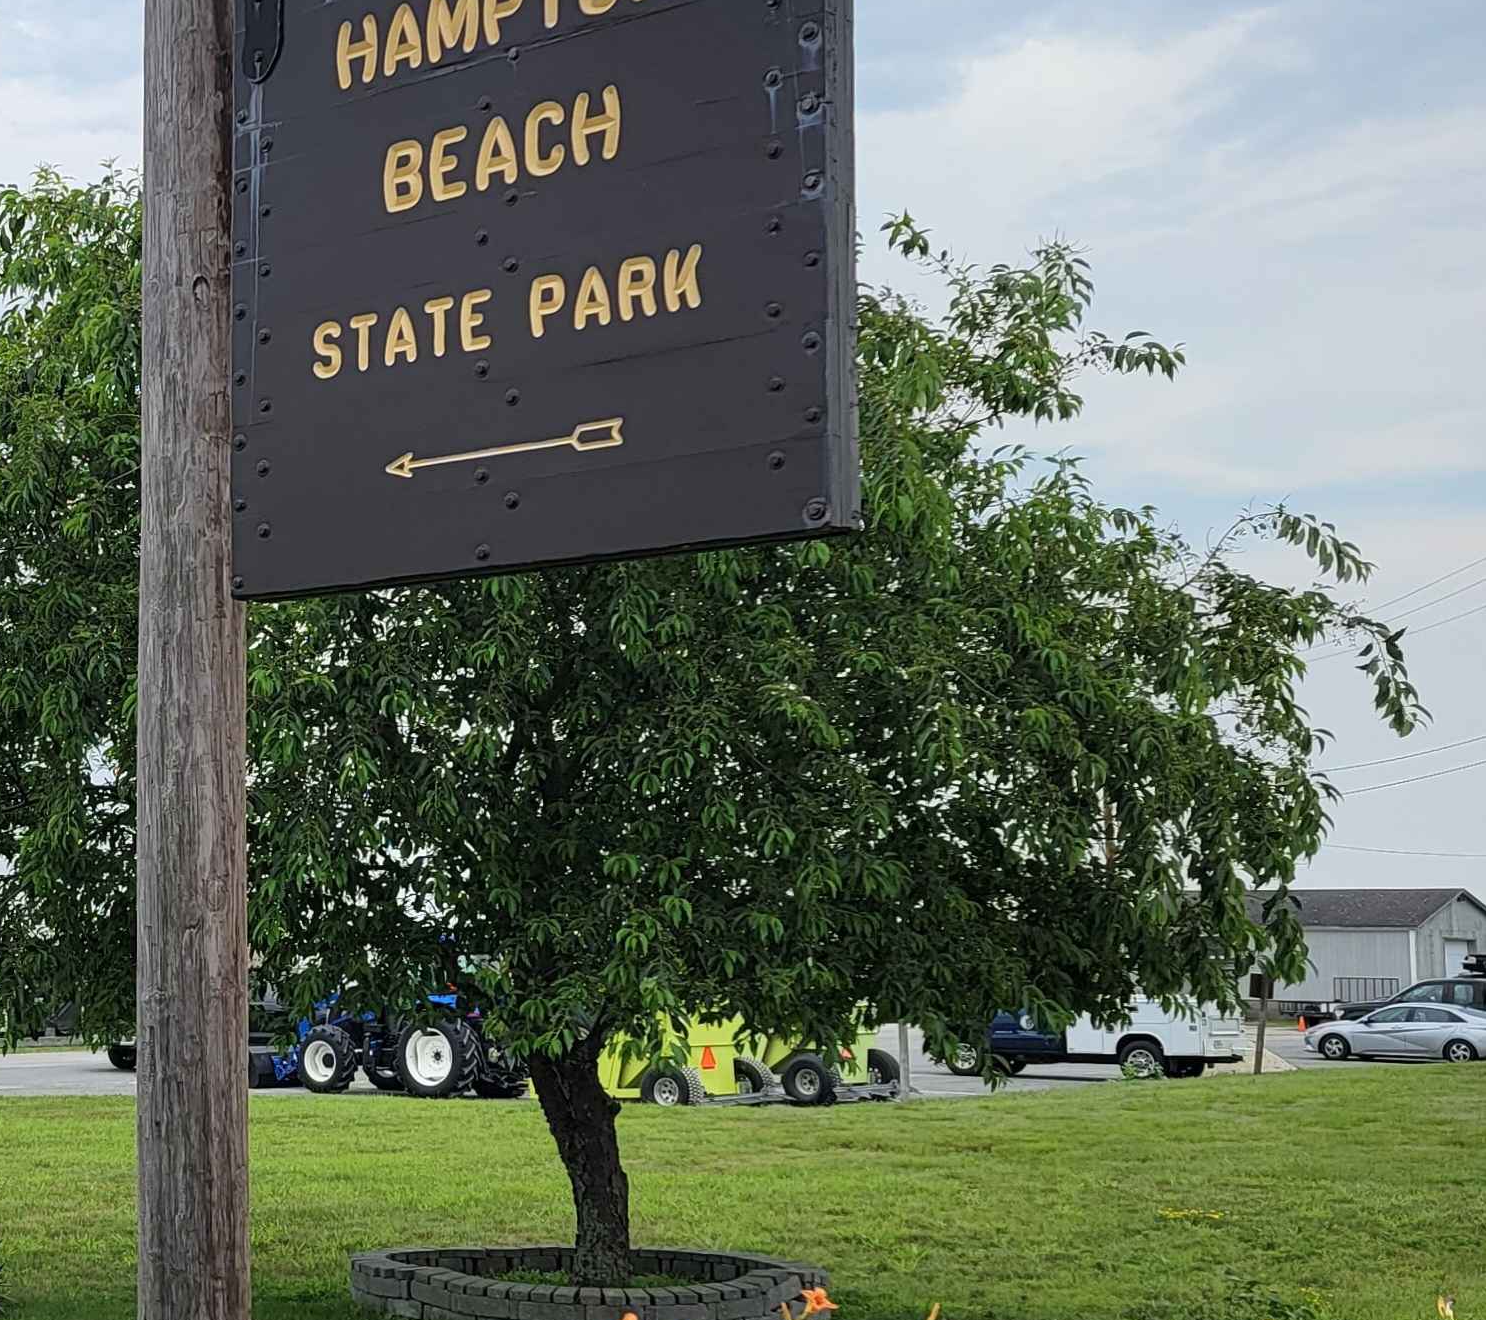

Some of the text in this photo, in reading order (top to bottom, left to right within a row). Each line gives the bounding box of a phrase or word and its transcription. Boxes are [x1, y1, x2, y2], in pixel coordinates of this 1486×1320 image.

[383, 84, 623, 213] BEACH
[313, 244, 703, 379] STATE PARK
